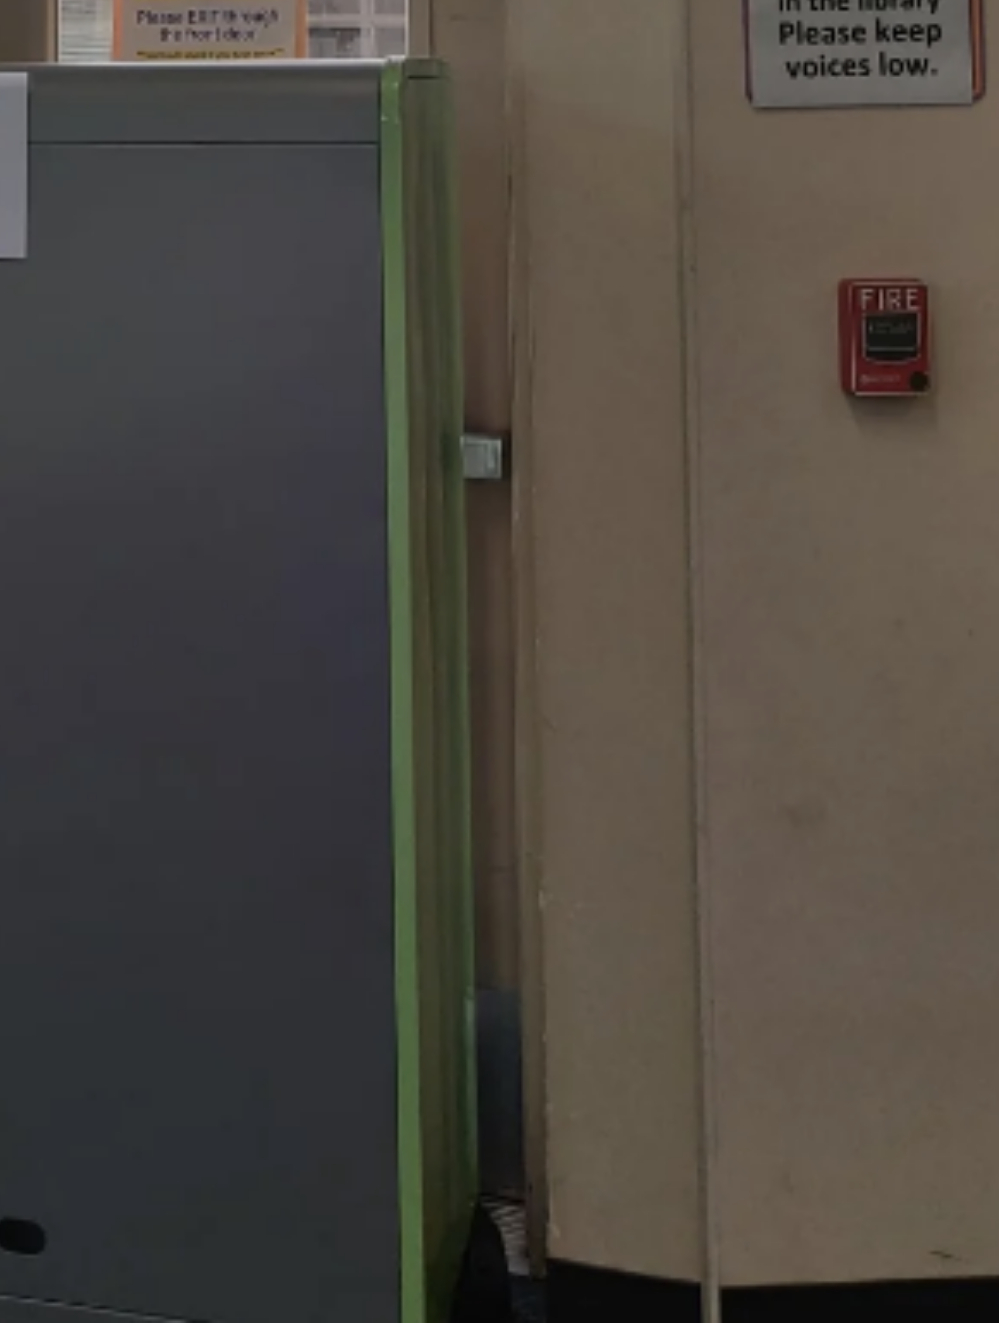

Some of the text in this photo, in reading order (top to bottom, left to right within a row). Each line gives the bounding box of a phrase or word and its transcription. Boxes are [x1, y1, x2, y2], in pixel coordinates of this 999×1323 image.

[778, 17, 942, 48] Please keep
[785, 51, 939, 79] voices low.
[860, 287, 921, 311] FIRE
